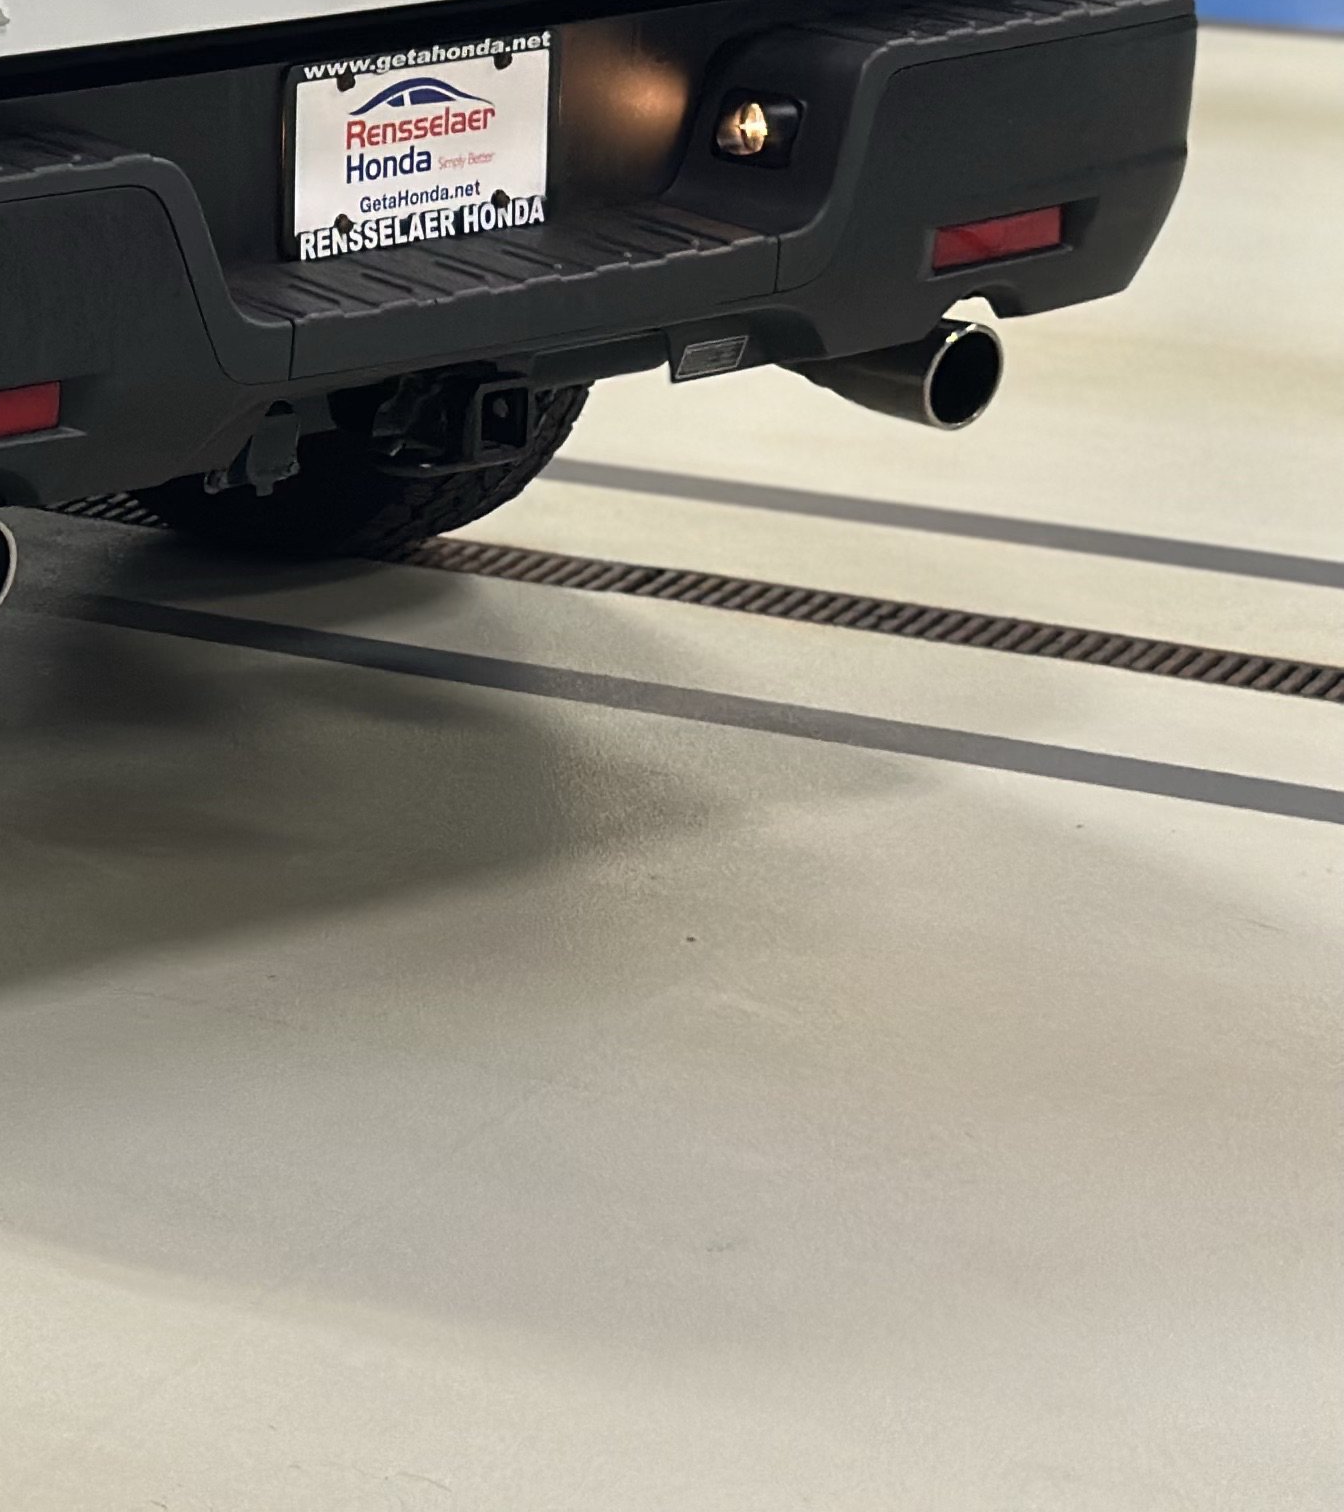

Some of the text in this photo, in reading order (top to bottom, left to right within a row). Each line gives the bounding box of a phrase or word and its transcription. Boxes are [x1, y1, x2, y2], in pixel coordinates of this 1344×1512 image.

[303, 31, 551, 79] www.getahonda.net
[346, 107, 495, 149] Rensselaer
[346, 145, 432, 184] Honda
[359, 179, 481, 213] GetaHonda.net
[300, 196, 545, 261] RENSSELAER HONDA
